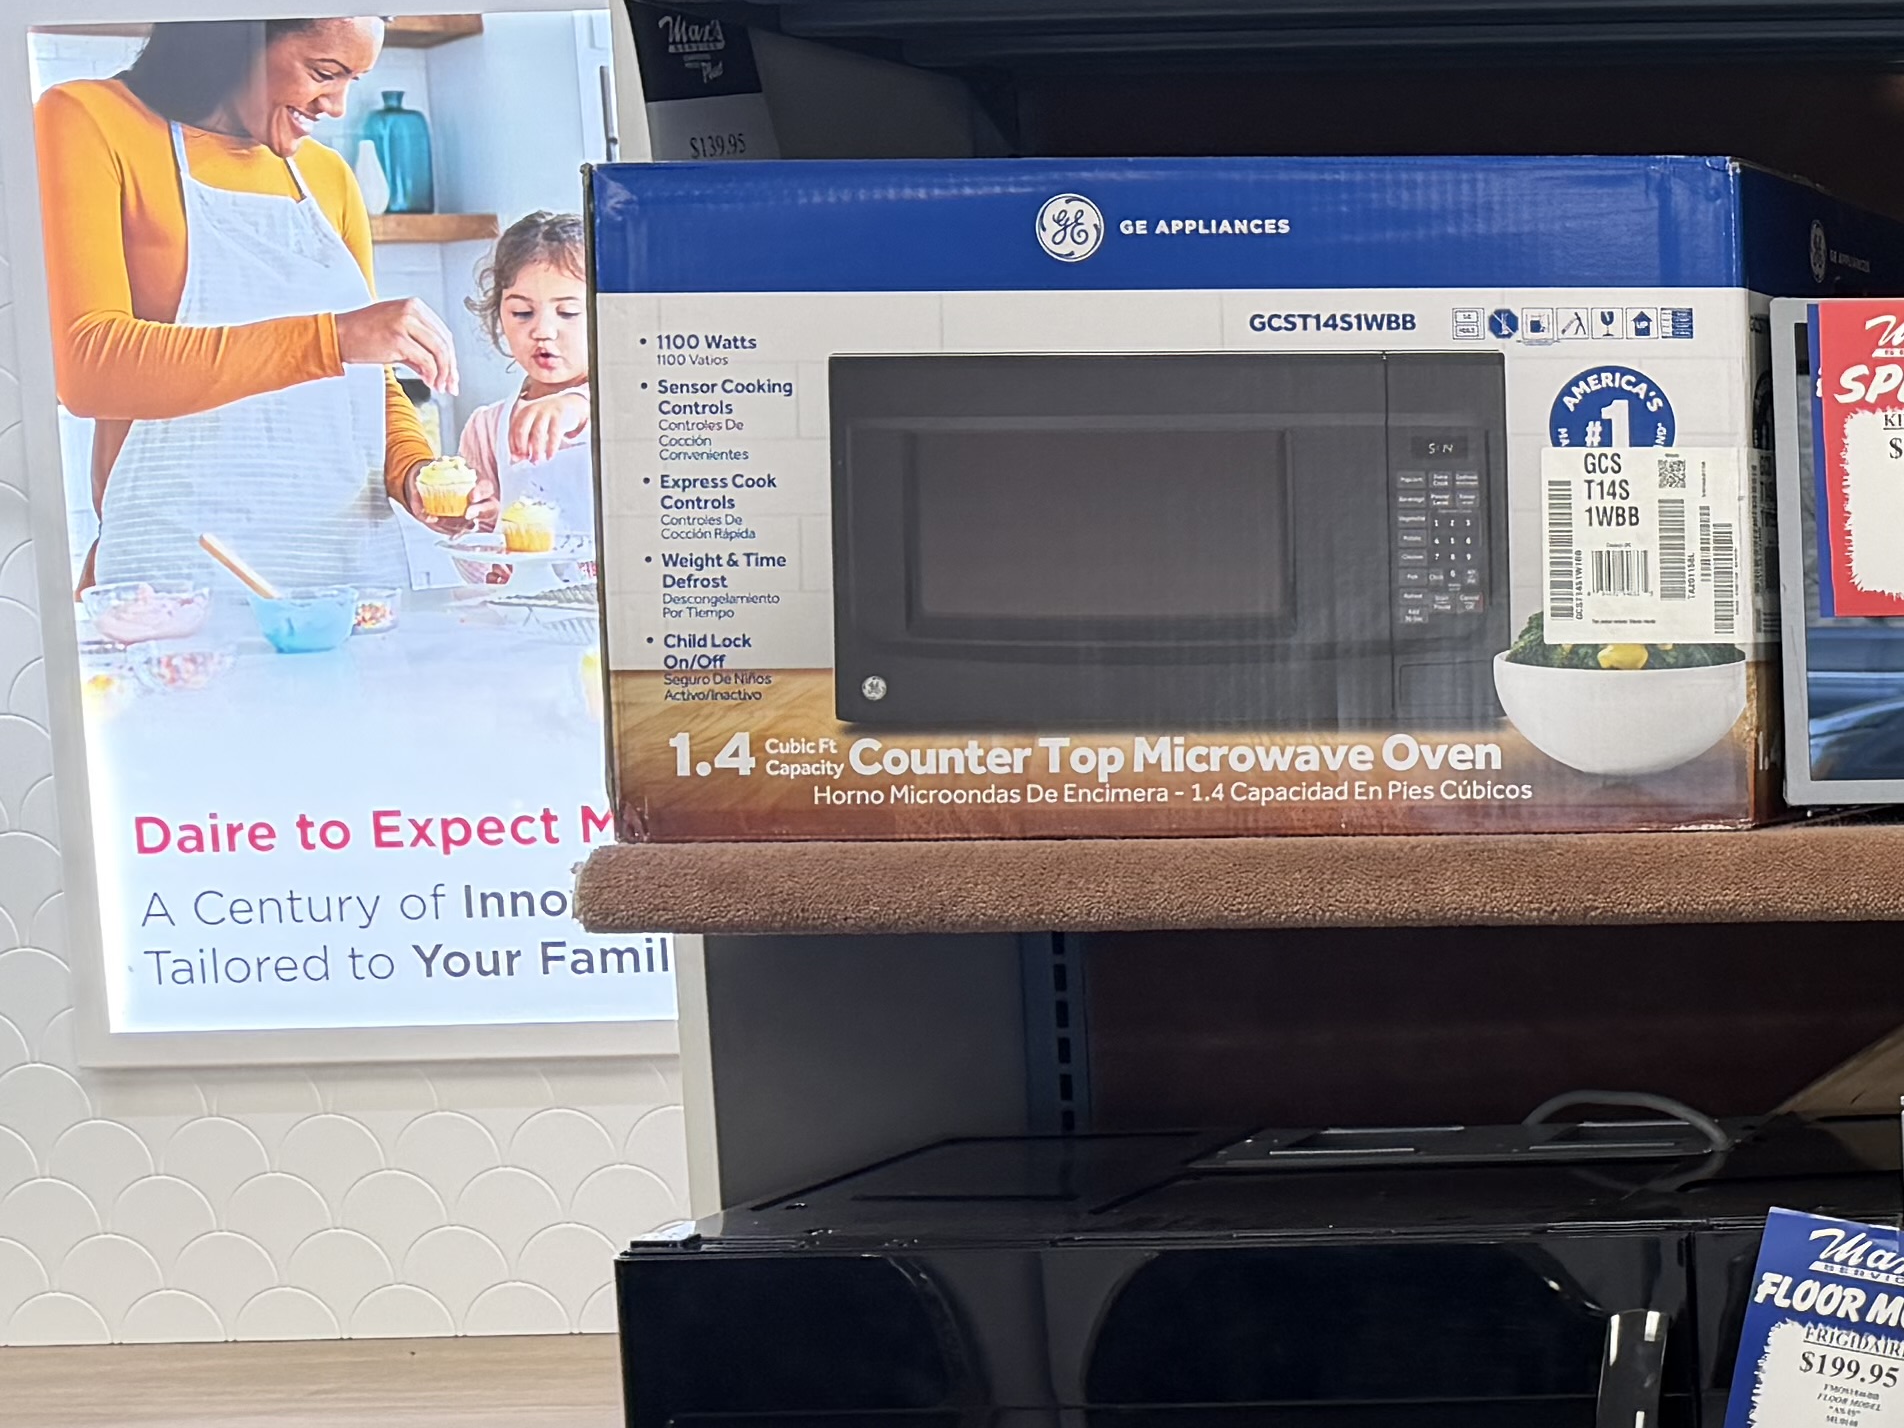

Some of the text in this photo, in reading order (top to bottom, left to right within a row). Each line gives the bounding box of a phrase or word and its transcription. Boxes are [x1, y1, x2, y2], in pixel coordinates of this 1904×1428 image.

[1119, 218, 1290, 235] GE APPLIANCES
[1249, 313, 1417, 332] GCST14S1WBB
[657, 334, 756, 350] 1100 Watts
[658, 379, 793, 396] Sensor Cooking
[1561, 373, 1663, 414] AMERICA'S
[658, 401, 733, 415] Controls
[1584, 452, 1622, 475] GCS
[1586, 479, 1630, 501] T14S
[1585, 505, 1640, 527] 1WBB
[669, 731, 1502, 782] 1.4 Counter Top Microwave Oven
[813, 778, 1533, 805] Horno Microondas De Encimera 1.4 Capacidad En Pies Cúbicos
[135, 808, 559, 855] Daire to Expect
[141, 883, 574, 929] A Century of Inno
[144, 938, 669, 986] Tailored to Your Famil
[1754, 1272, 1866, 1322] FLOOR
[1799, 1351, 1900, 1389] $199.95
